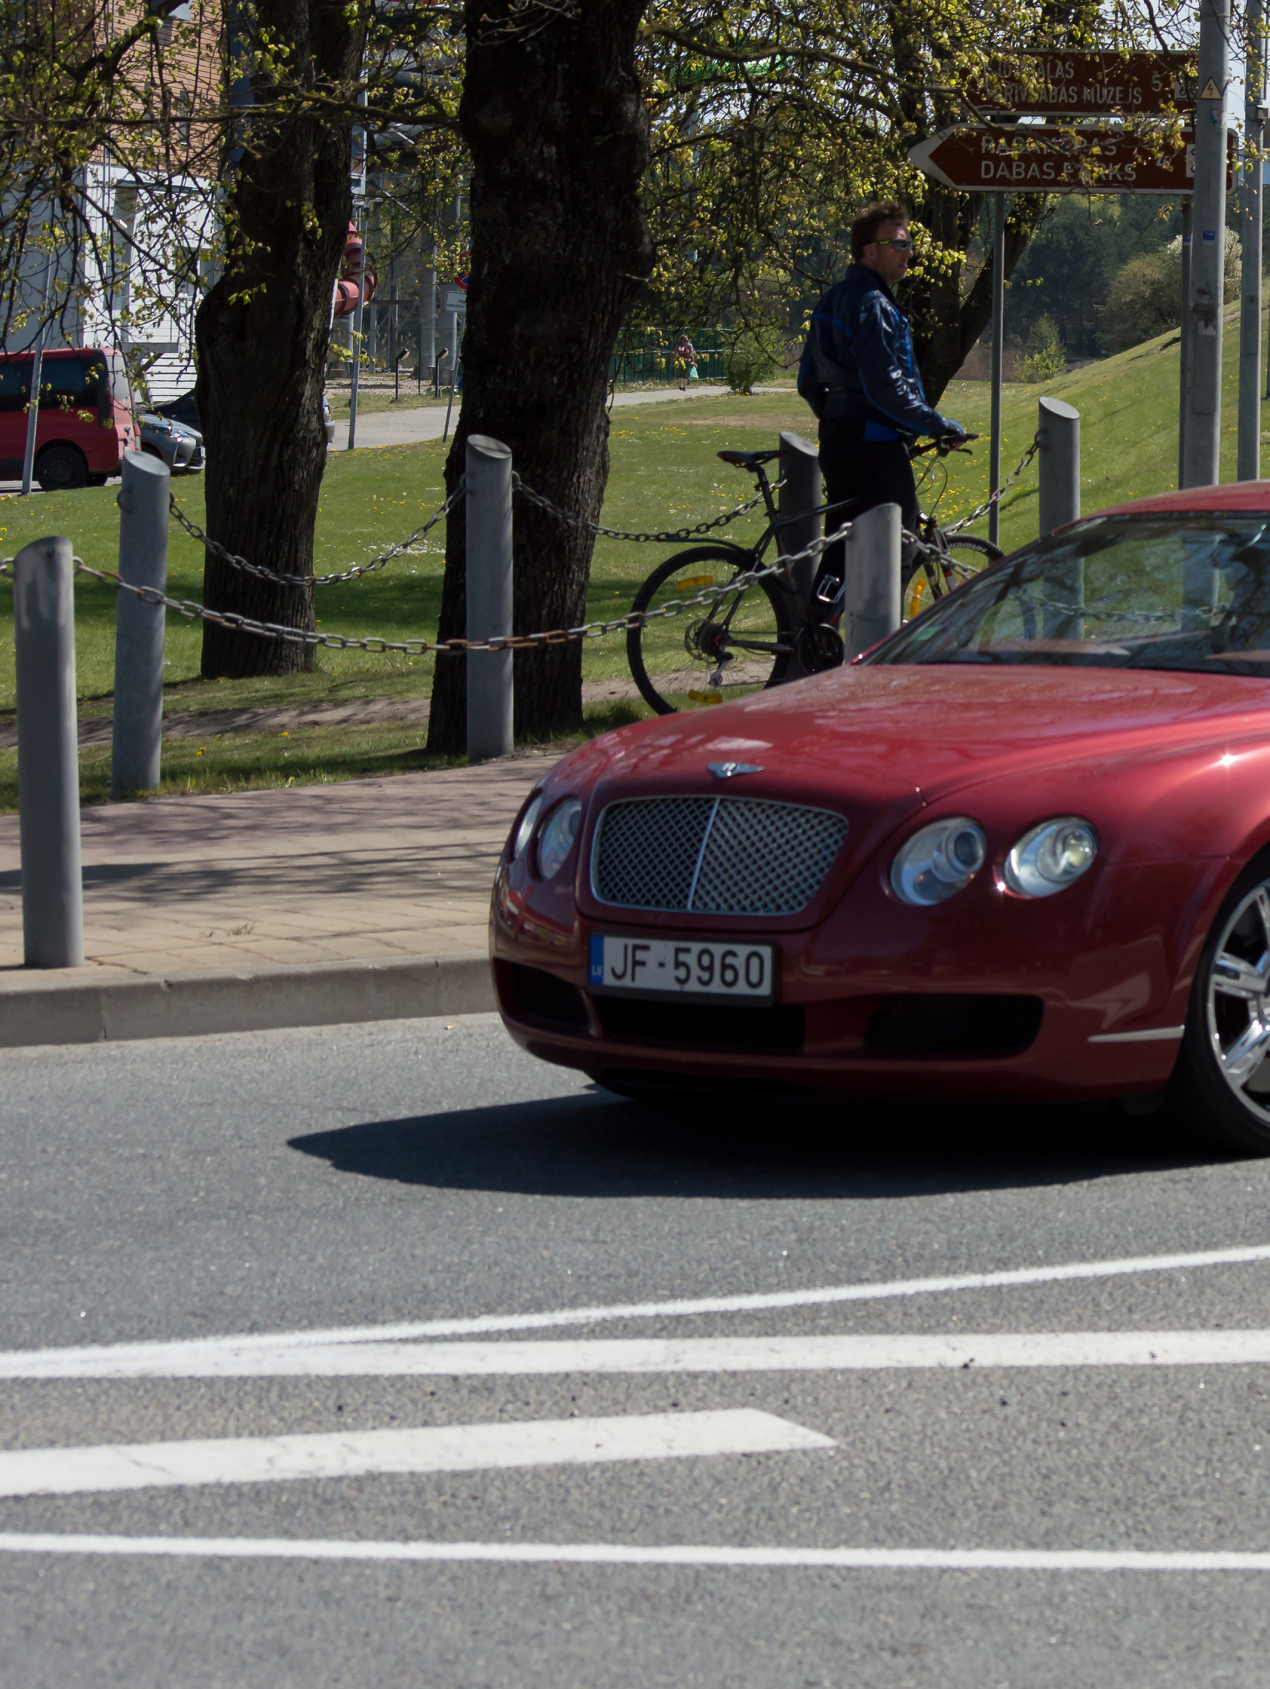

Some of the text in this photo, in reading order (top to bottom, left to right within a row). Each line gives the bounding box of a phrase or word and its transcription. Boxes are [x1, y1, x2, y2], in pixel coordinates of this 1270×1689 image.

[1152, 75, 1163, 92] 5
[1083, 86, 1143, 104] MUZEJS
[981, 160, 1137, 181] DABAS PRKS
[610, 943, 765, 990] JF-5960
